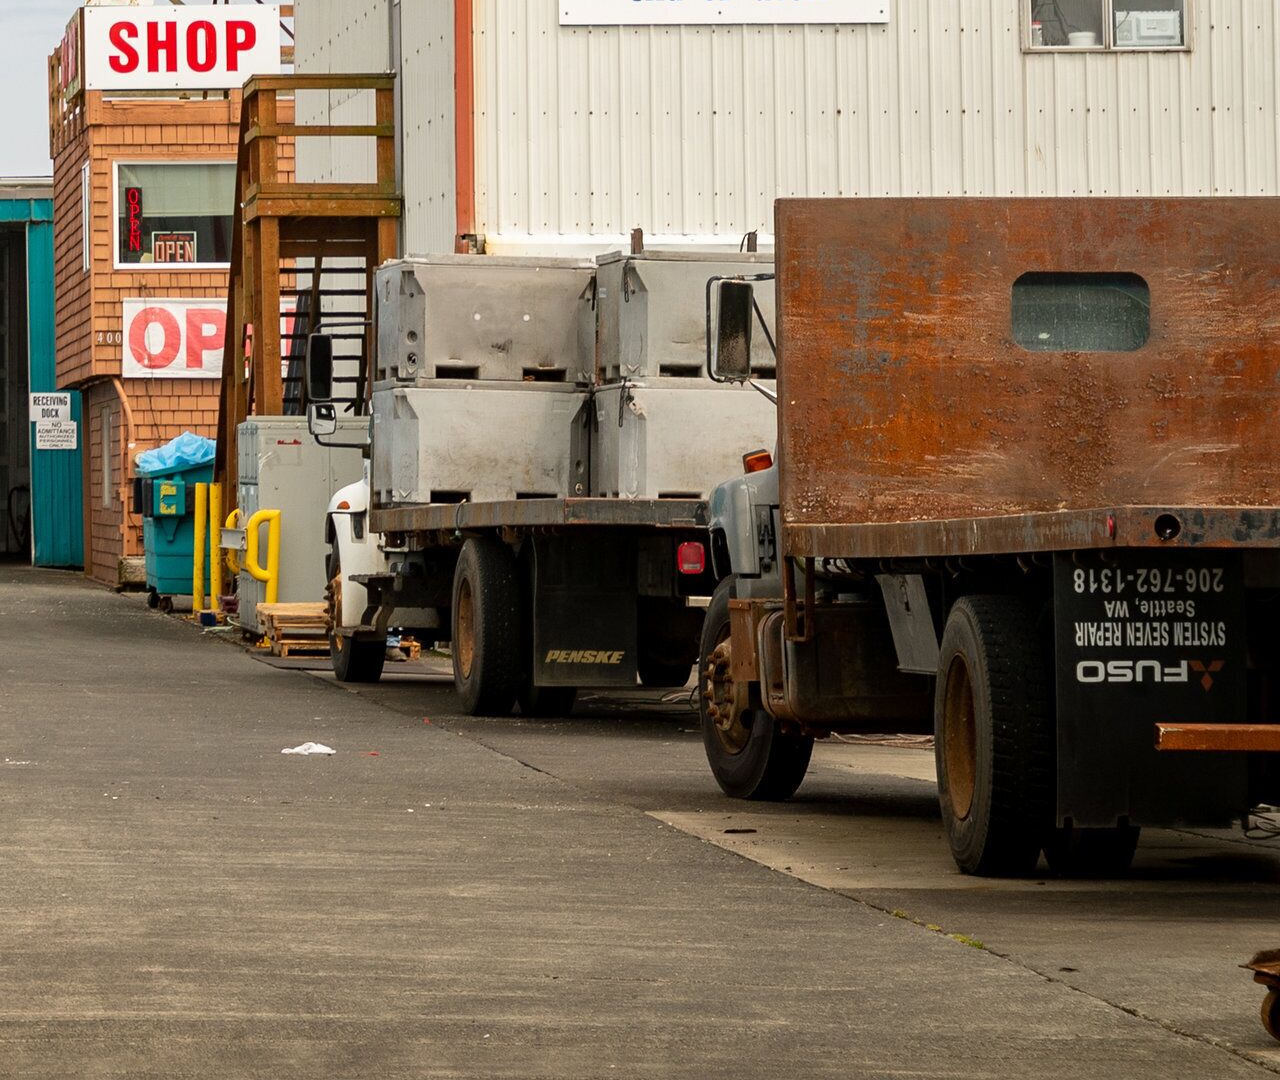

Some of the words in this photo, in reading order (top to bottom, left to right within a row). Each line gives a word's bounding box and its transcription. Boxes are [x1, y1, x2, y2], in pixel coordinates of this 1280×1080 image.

[108, 20, 257, 74] SHOP
[128, 188, 141, 252] OPEN
[155, 241, 194, 263] OPEN
[97, 331, 121, 344] 400
[32, 396, 68, 406] RECEIVING
[41, 408, 60, 418] DOCK
[1073, 568, 1224, 593] 206-762-1318
[1104, 601, 1130, 618] WA
[1134, 600, 1196, 617] Seattle,
[1075, 622, 1122, 646] REPAIR
[1126, 622, 1169, 646] SEVEN
[1173, 622, 1226, 646] SYSTEM
[545, 650, 625, 664] PENSKE
[1076, 660, 1188, 682] FUSO
